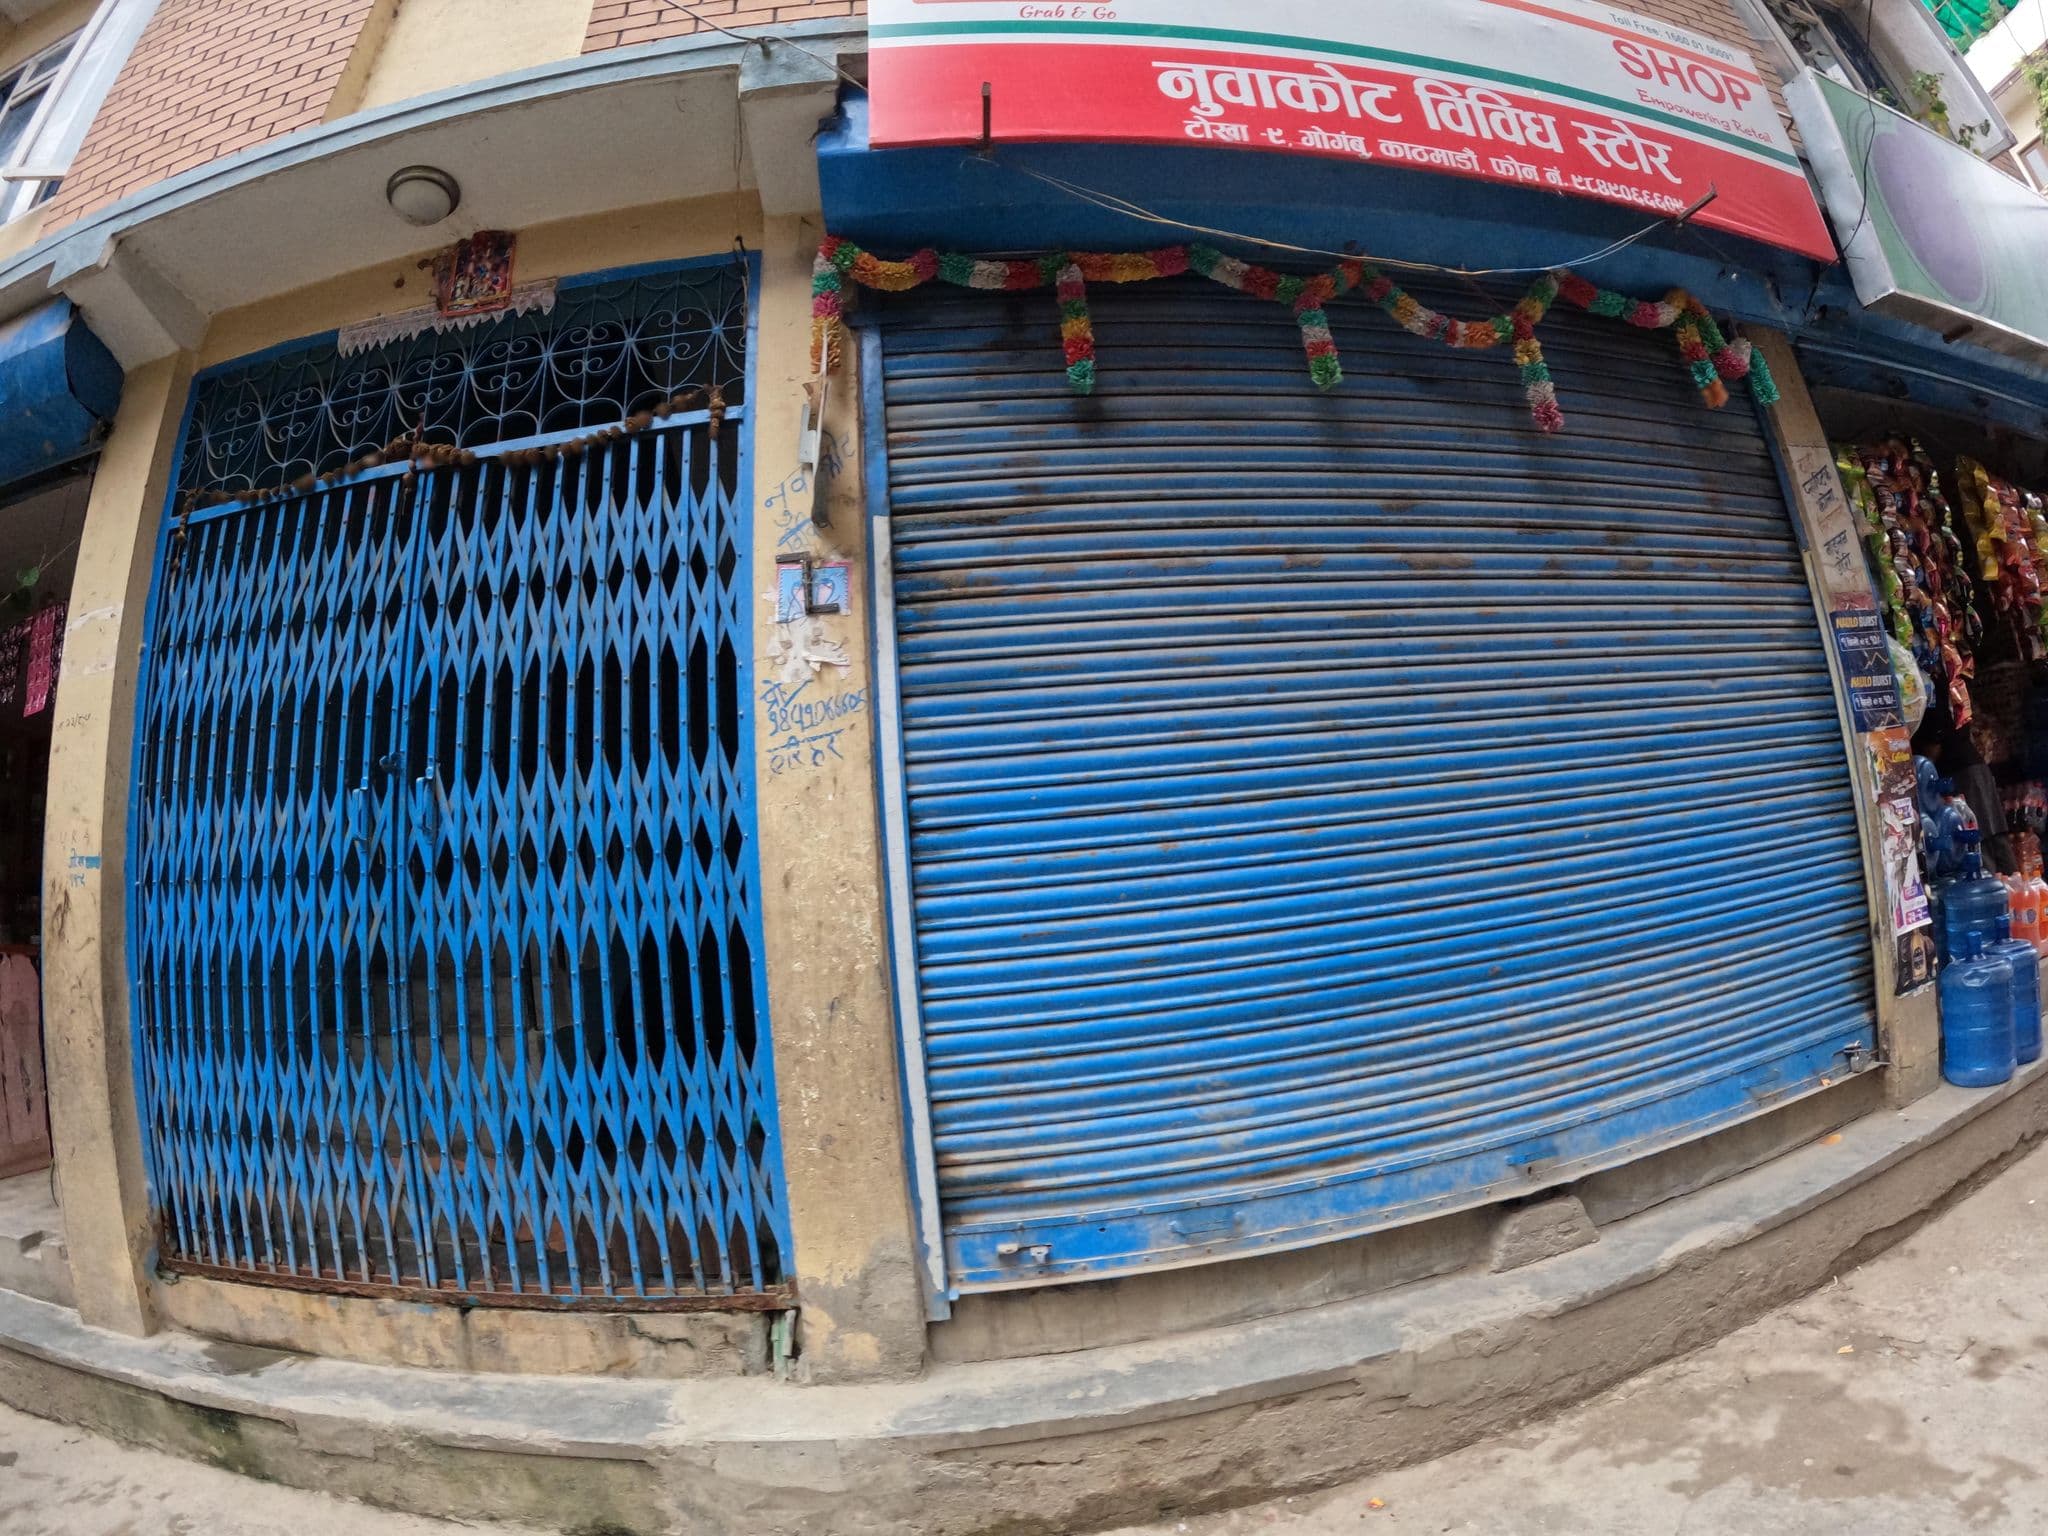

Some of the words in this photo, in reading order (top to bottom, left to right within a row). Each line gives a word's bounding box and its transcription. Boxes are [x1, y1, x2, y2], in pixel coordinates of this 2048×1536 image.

[1020, 5, 1065, 18] Grab
[1071, 6, 1087, 18] &
[1093, 7, 1117, 19] Go
[1609, 12, 1632, 26] Toll
[1612, 39, 1752, 112] SHOP
[1152, 61, 1403, 124] नुवाकोट
[1412, 78, 1564, 153] विविध
[1570, 119, 1682, 184] स्टोर
[1636, 88, 1730, 132] Empowering
[1731, 119, 1774, 144] Retail
[1183, 115, 1249, 142] टोखा
[1488, 154, 1541, 182] फोन
